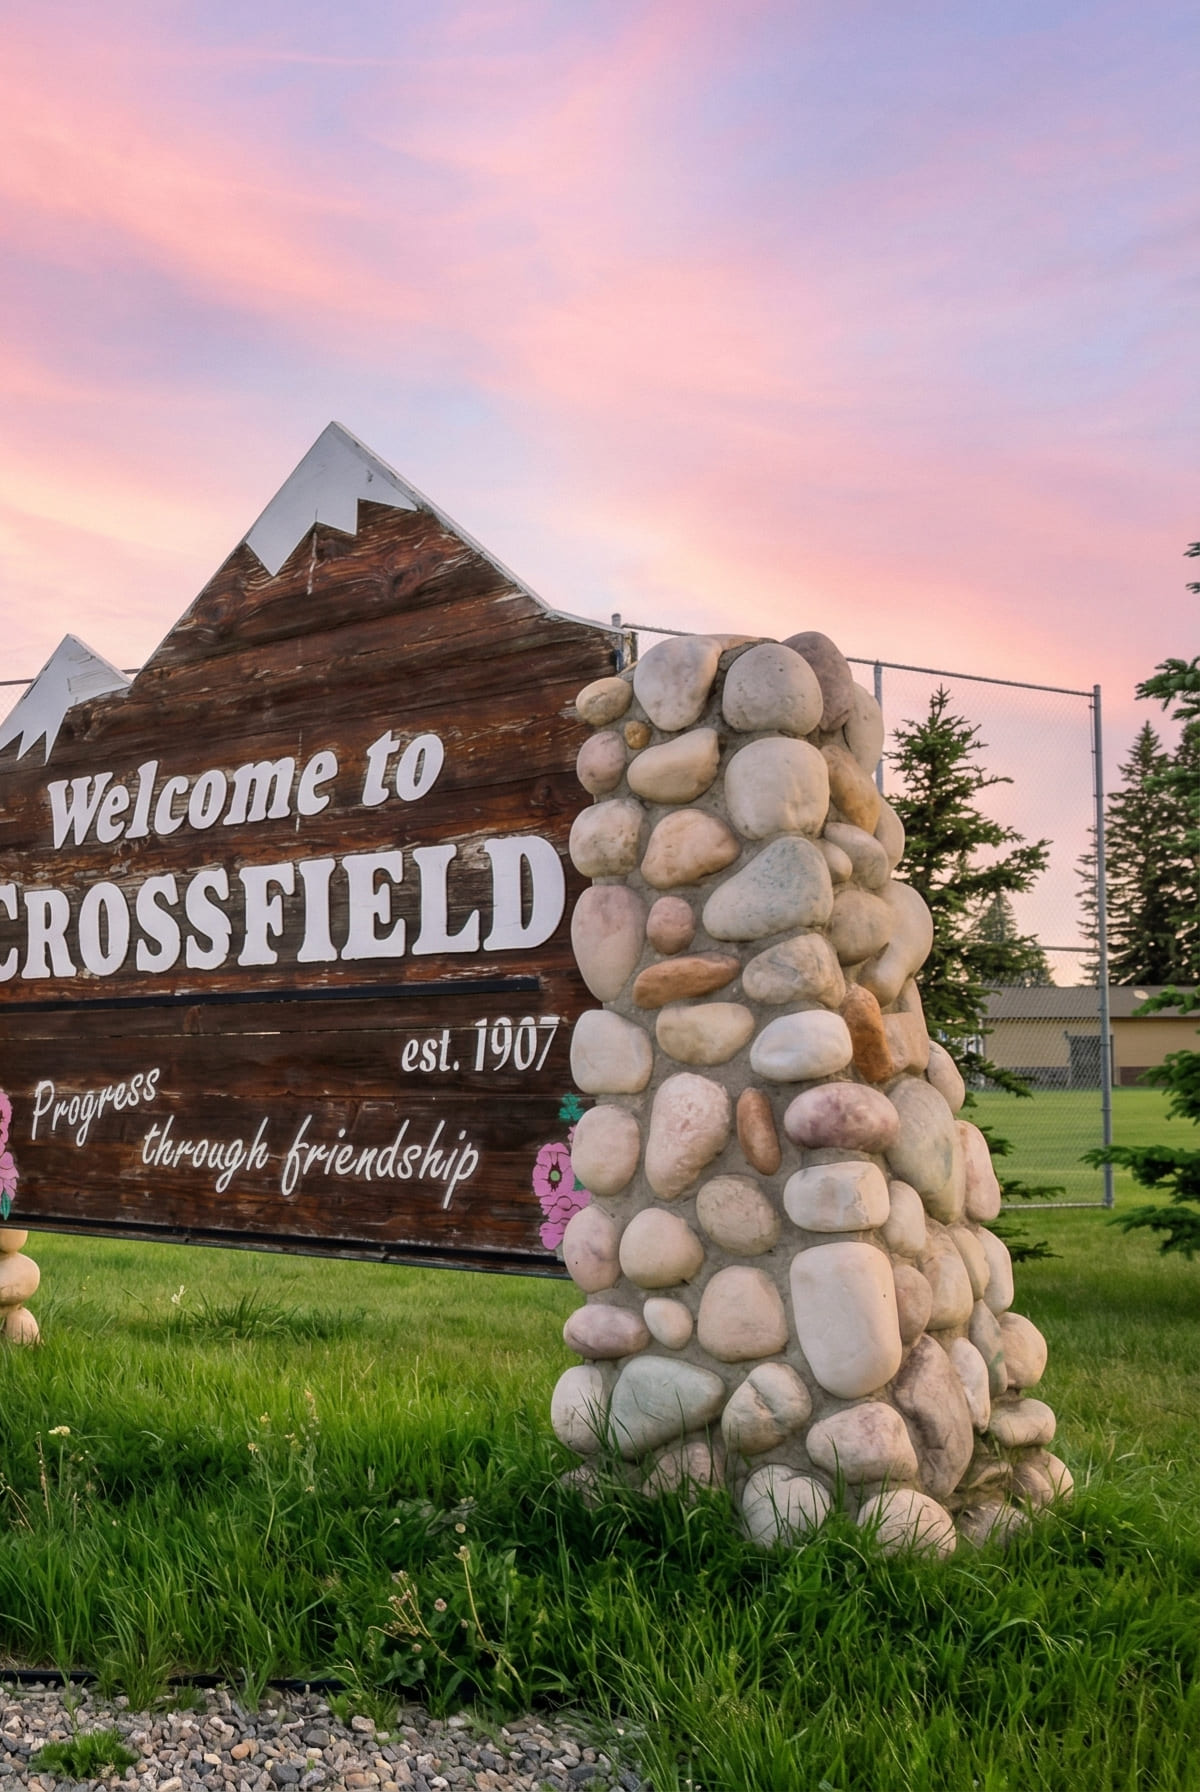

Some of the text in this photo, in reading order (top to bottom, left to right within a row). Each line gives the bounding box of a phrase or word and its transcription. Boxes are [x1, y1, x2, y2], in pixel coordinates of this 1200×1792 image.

[46, 729, 445, 850] Welcome to
[401, 1016, 561, 1073] est. 1907
[31, 1067, 160, 1146] Progress
[141, 1113, 480, 1208] through friendship
